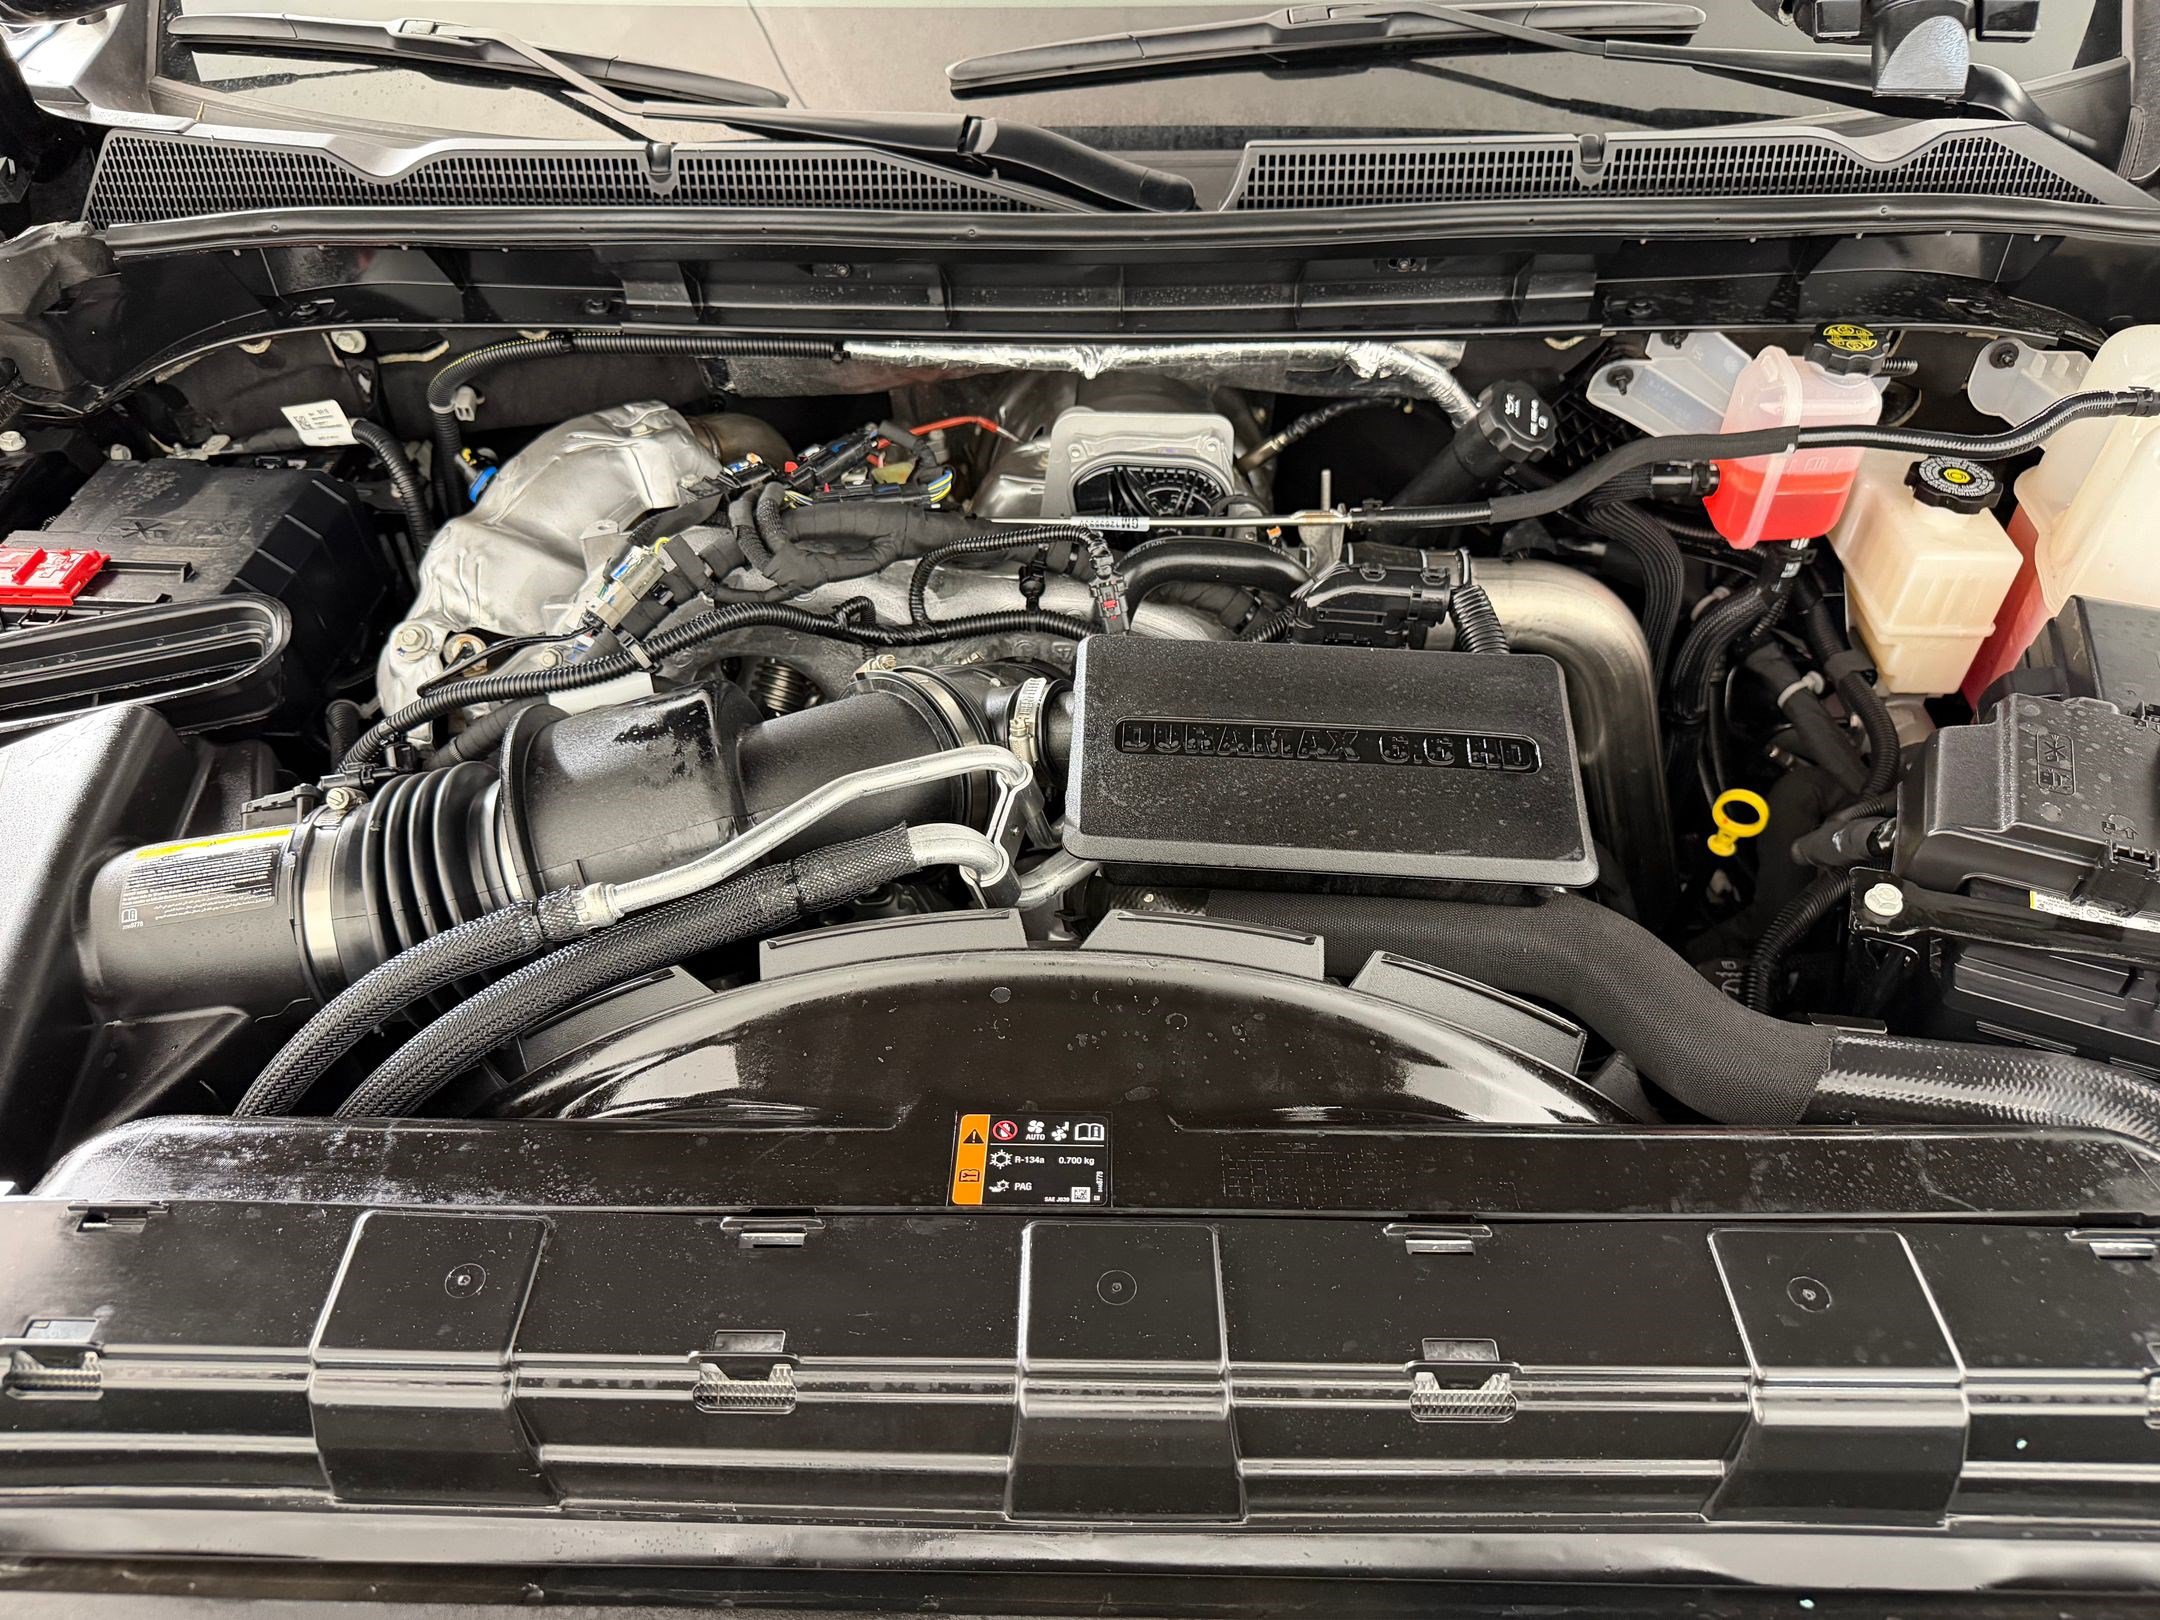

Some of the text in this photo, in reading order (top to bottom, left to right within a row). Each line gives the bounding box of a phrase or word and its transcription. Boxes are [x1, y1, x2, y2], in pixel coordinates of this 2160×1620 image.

[1121, 517, 1139, 529] GM
[1122, 722, 1533, 771] DURAMAX 6.6 HD
[1026, 1133, 1046, 1141] AUTO
[1014, 1155, 1095, 1166] R-134a 0.700 kg
[1014, 1182, 1032, 1191] PAG
